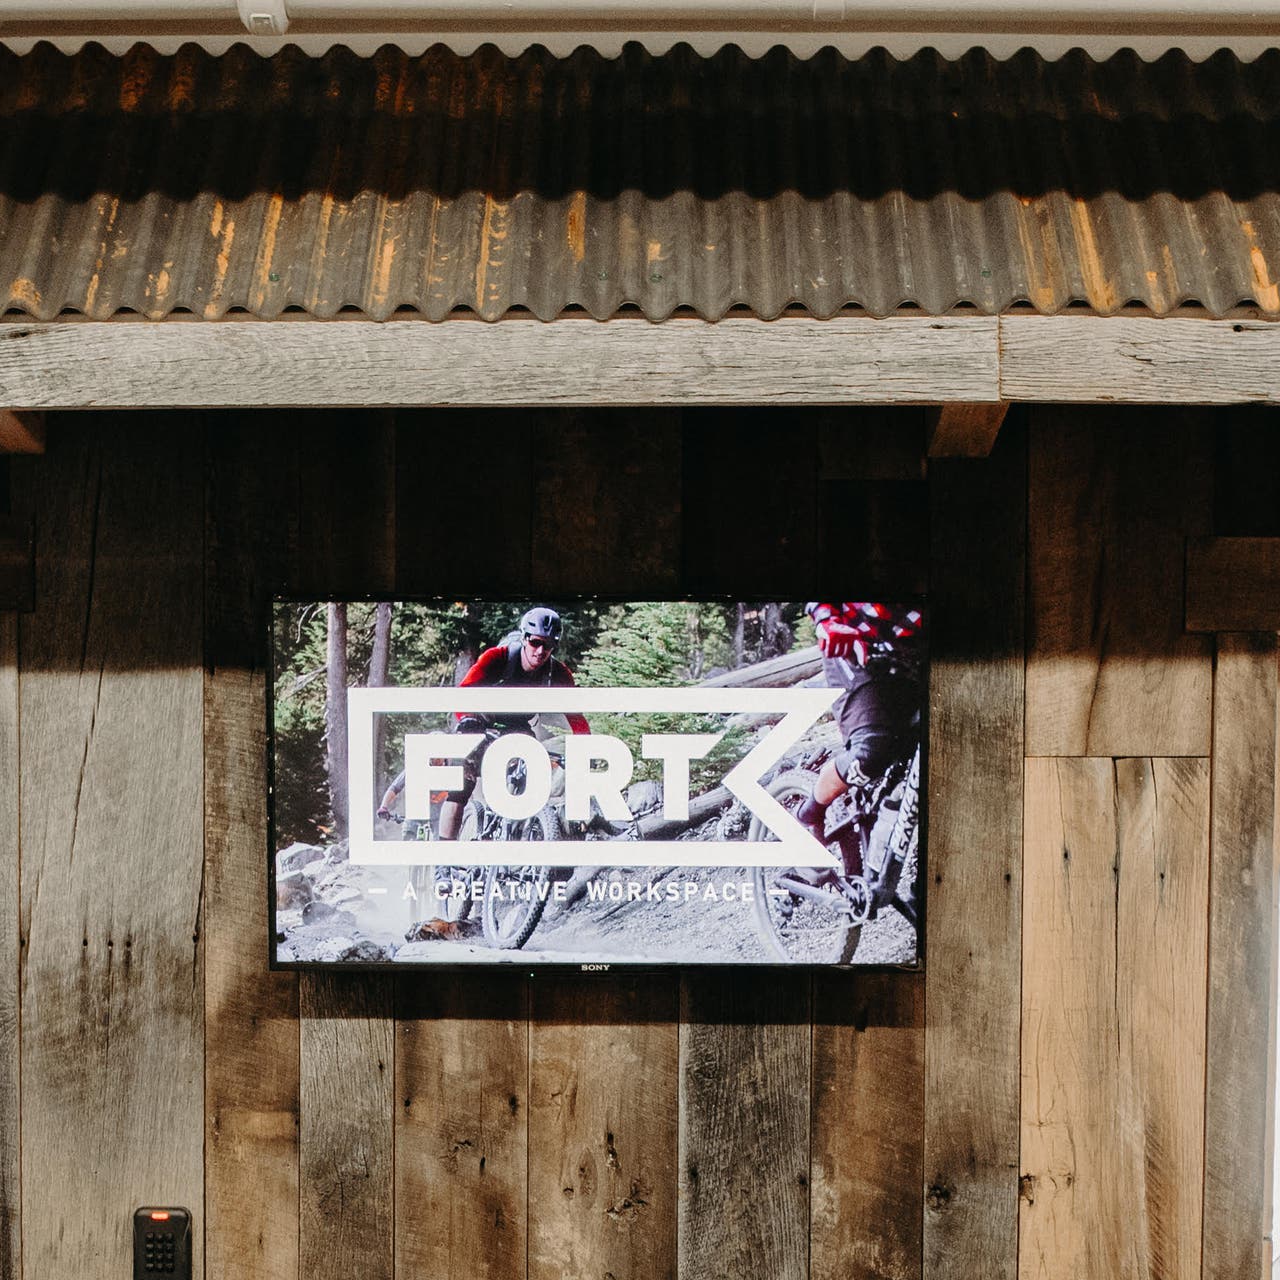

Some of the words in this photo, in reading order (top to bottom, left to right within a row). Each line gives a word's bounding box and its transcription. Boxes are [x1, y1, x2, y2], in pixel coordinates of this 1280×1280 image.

[405, 733, 723, 821] FORT
[402, 881, 418, 900] A
[434, 881, 568, 901] CREATIVE
[586, 881, 755, 901] WORKSPACE
